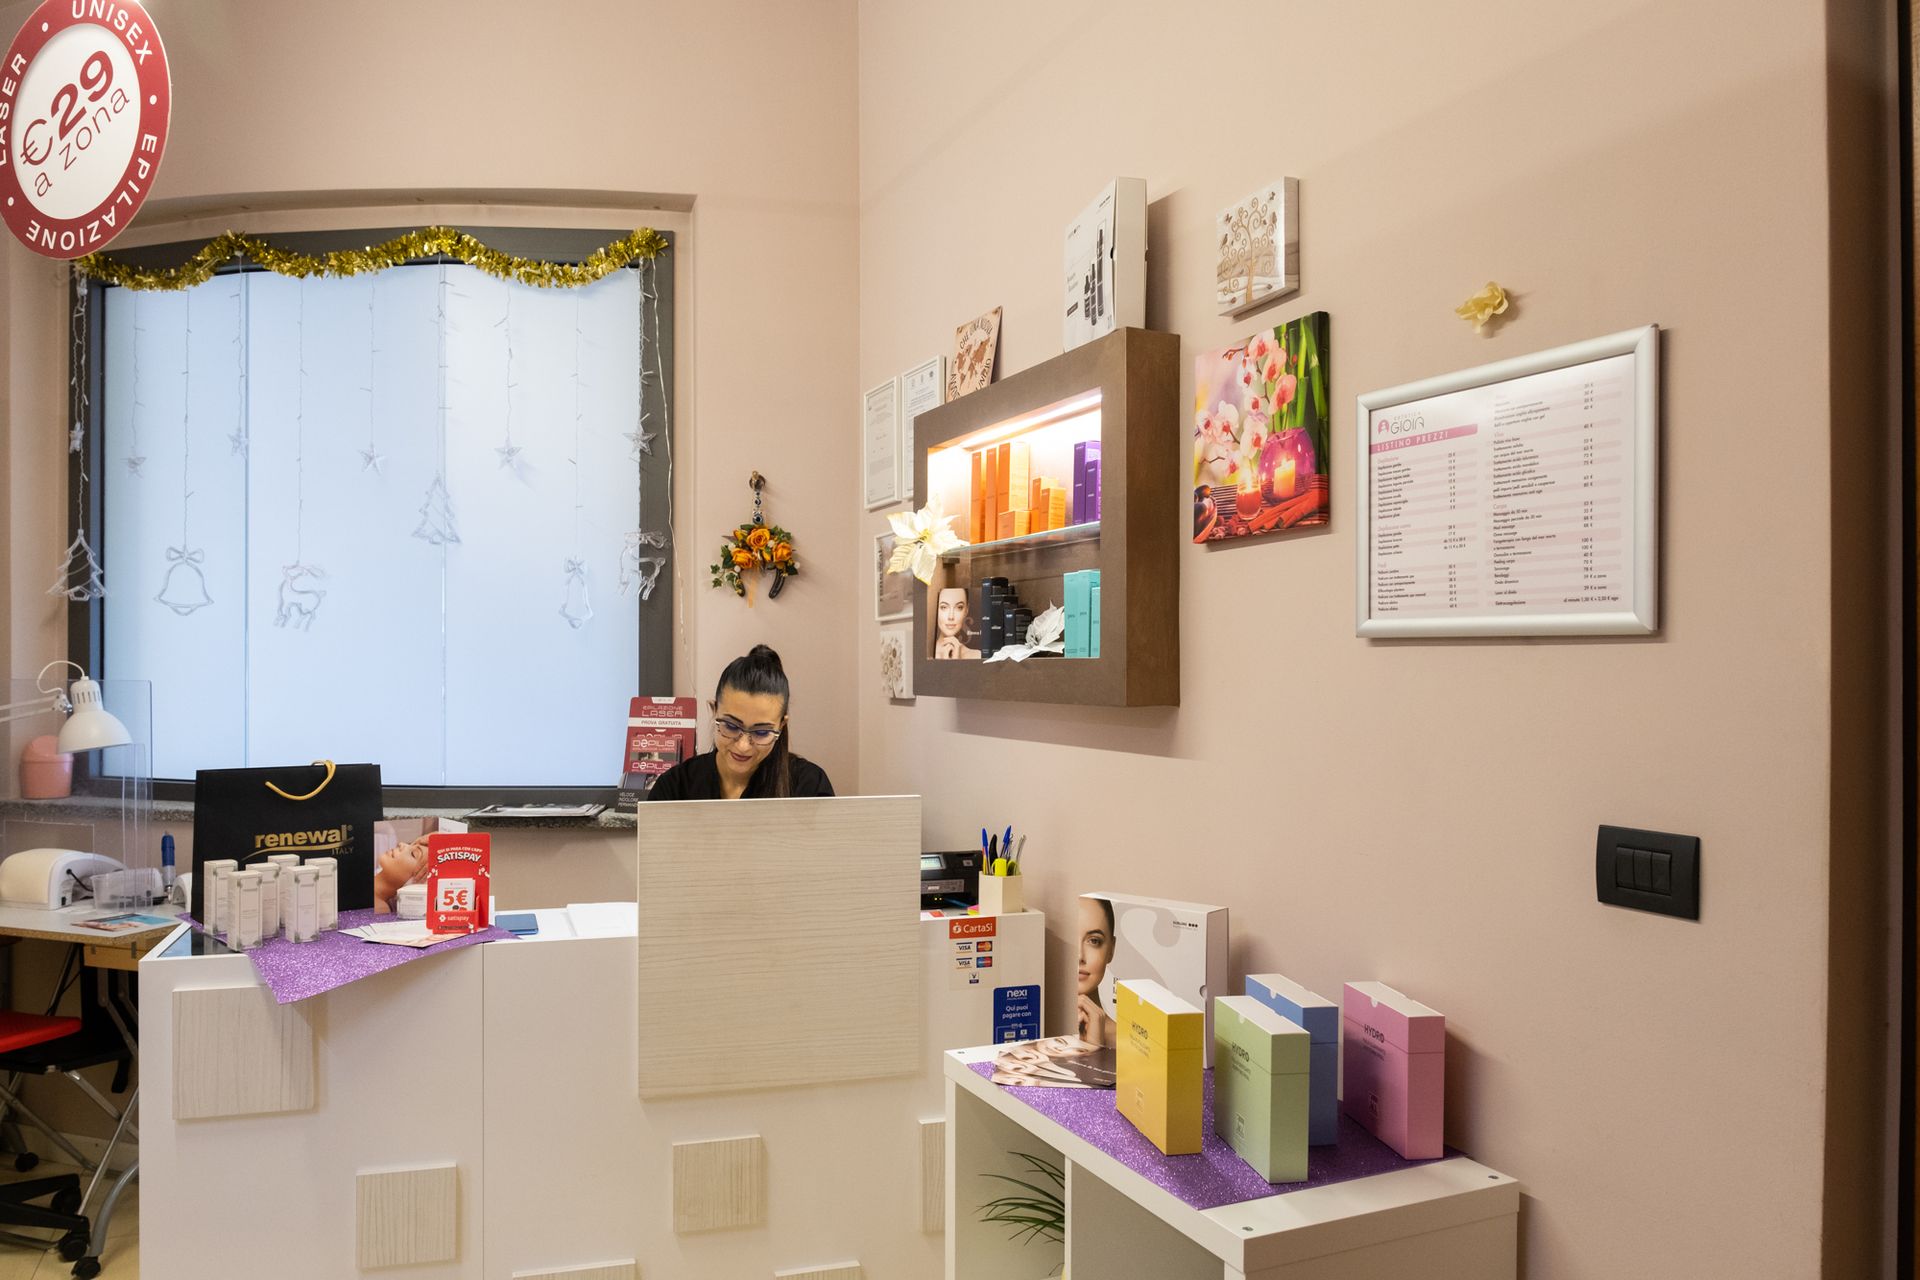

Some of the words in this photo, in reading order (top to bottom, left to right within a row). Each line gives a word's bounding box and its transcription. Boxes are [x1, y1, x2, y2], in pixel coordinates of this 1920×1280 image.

[72, 0, 152, 65] UNISEX
[34, 172, 53, 197] a
[59, 88, 130, 170] zona
[26, 133, 157, 250] EPILAZIONE
[1391, 416, 1424, 434] GIOIA
[1377, 438, 1411, 452] LISTINO
[1416, 431, 1449, 444] PREZZI
[255, 824, 347, 848] renewal
[331, 846, 354, 856] ITALY
[437, 851, 482, 863] SATISPAY
[447, 914, 470, 923] satispay
[963, 923, 993, 933] CartaSi
[1006, 989, 1027, 998] nexi
[1016, 1003, 1029, 1011] puoi
[1131, 1020, 1149, 1040] HYDRO
[1364, 1023, 1385, 1044] HYDRO
[1231, 1041, 1250, 1063] HYDRO
